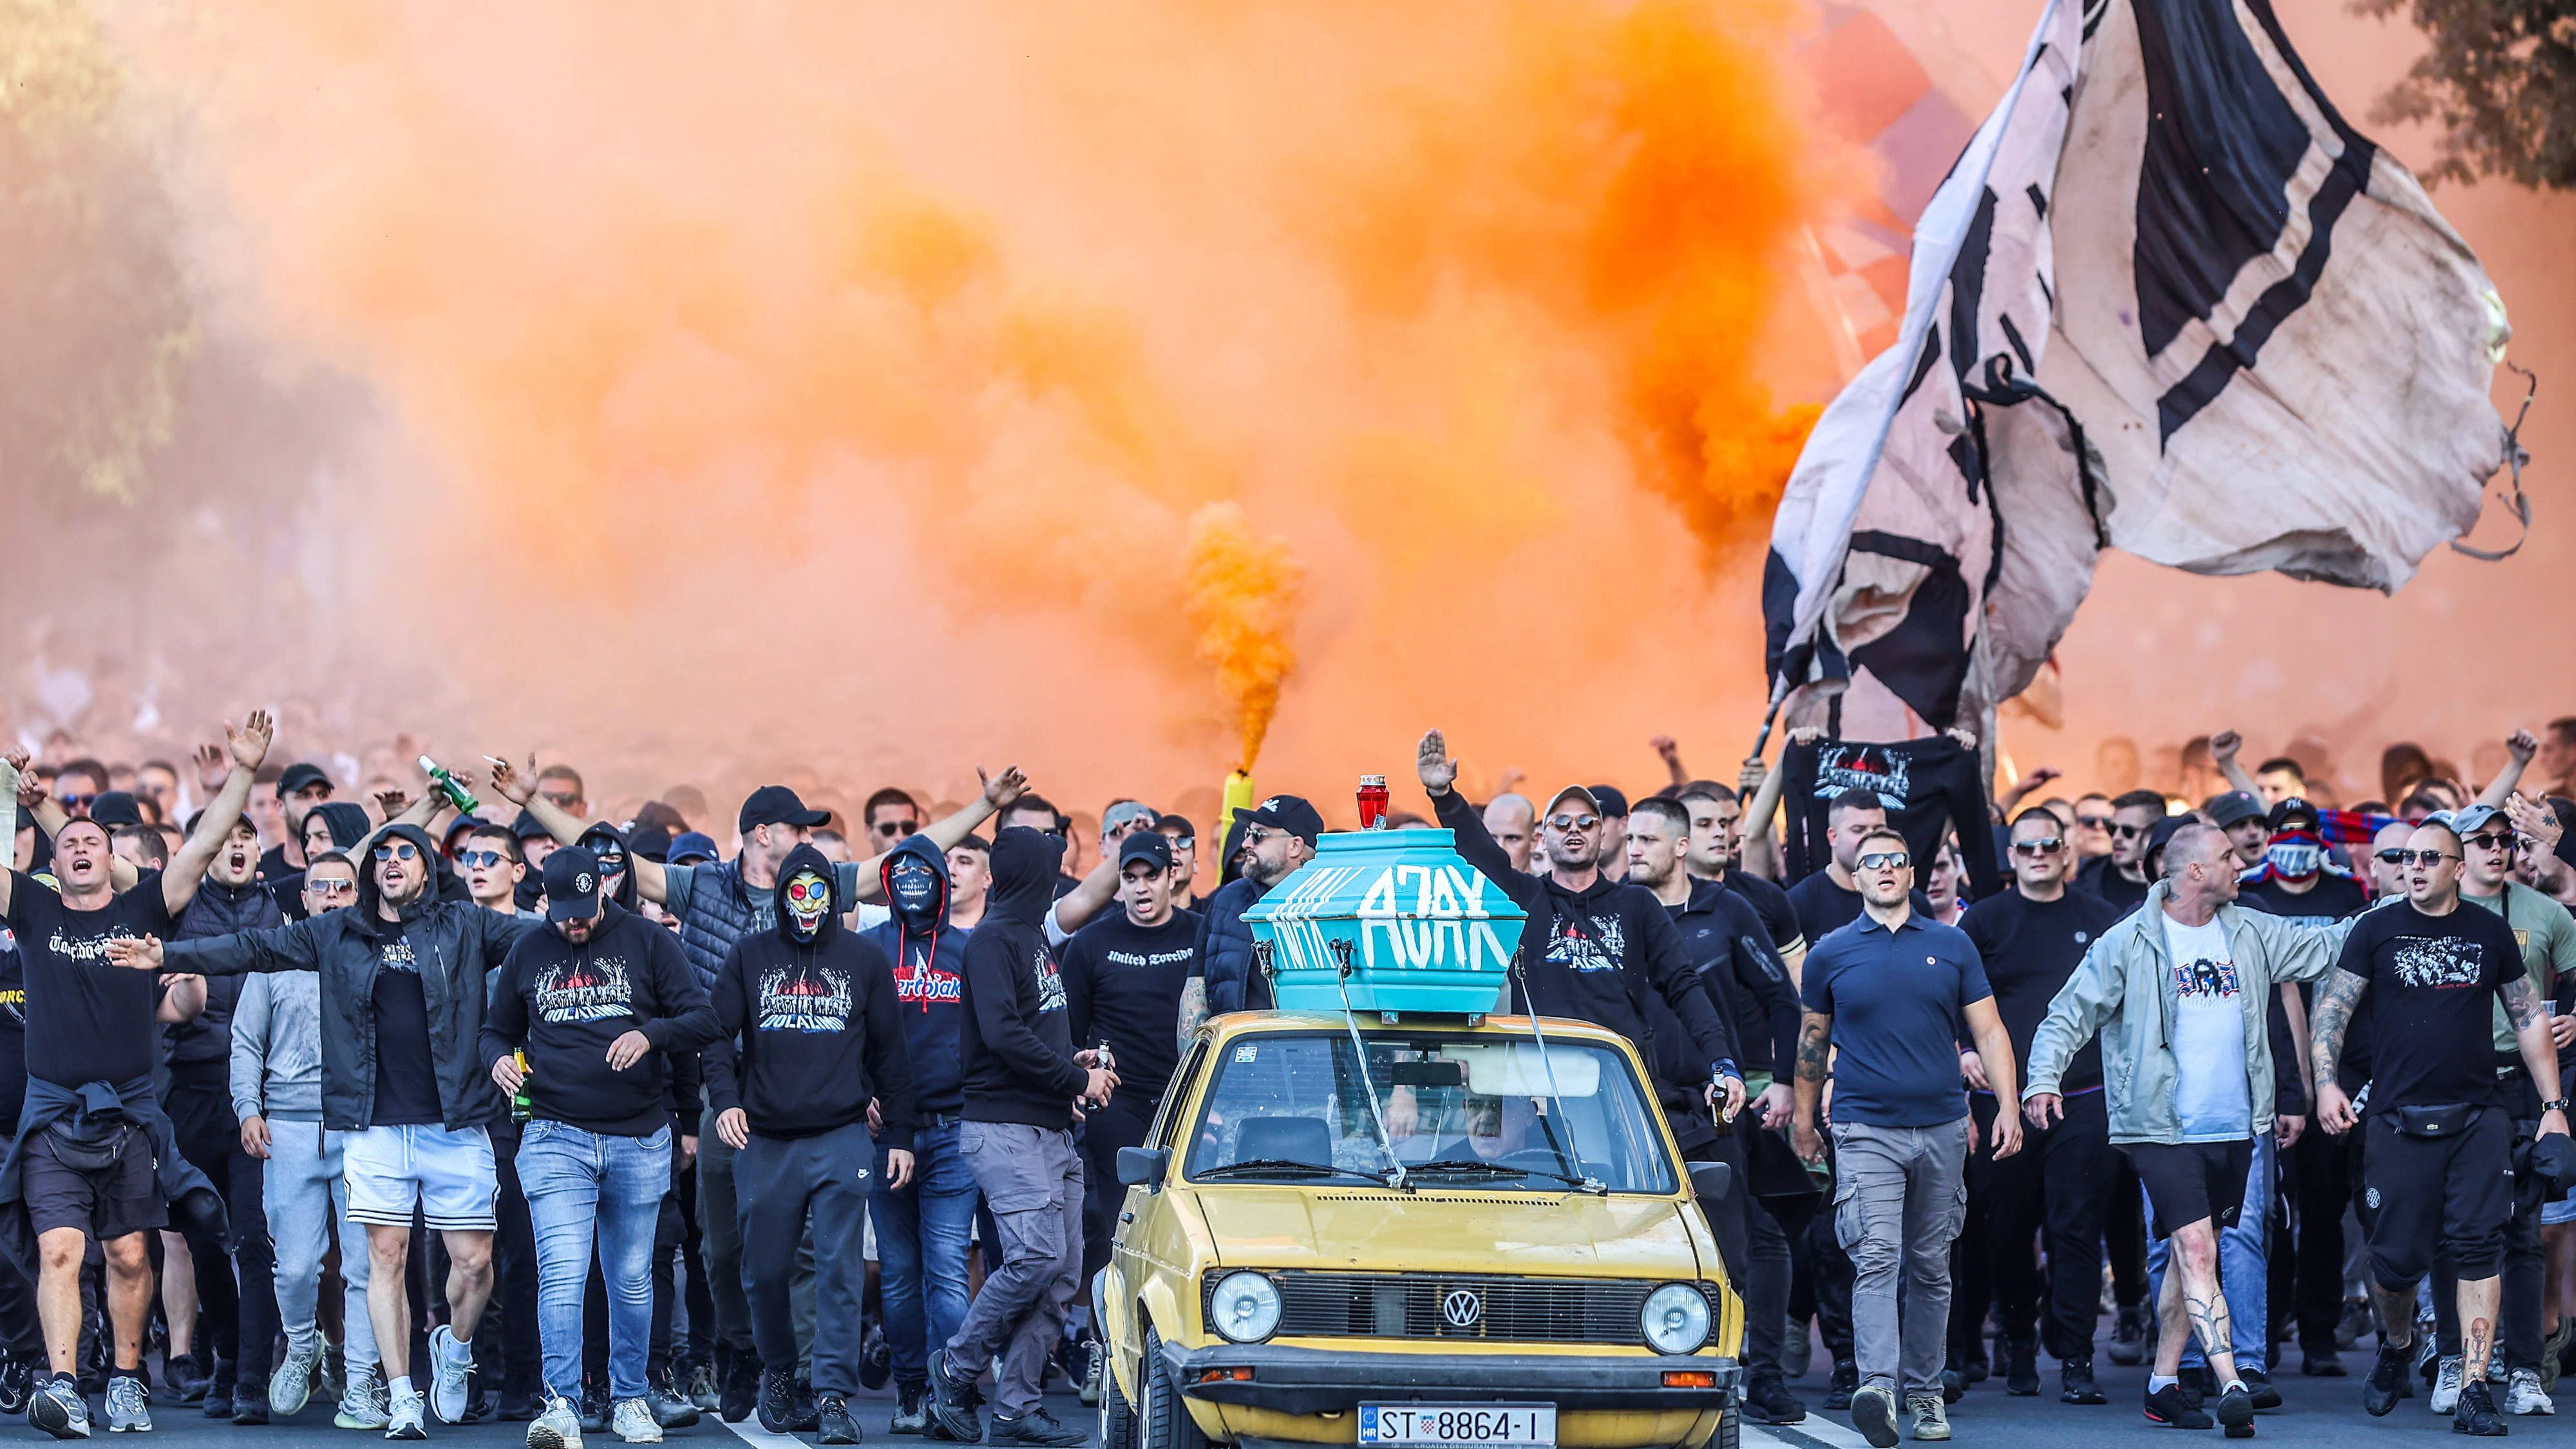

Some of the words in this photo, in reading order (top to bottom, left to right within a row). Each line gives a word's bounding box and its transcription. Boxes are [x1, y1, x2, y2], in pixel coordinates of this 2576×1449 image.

[1106, 951, 1146, 967] United
[897, 973, 961, 1000] ertojak
[1363, 1428, 1377, 1437] HR
[1382, 1412, 1416, 1439] ST
